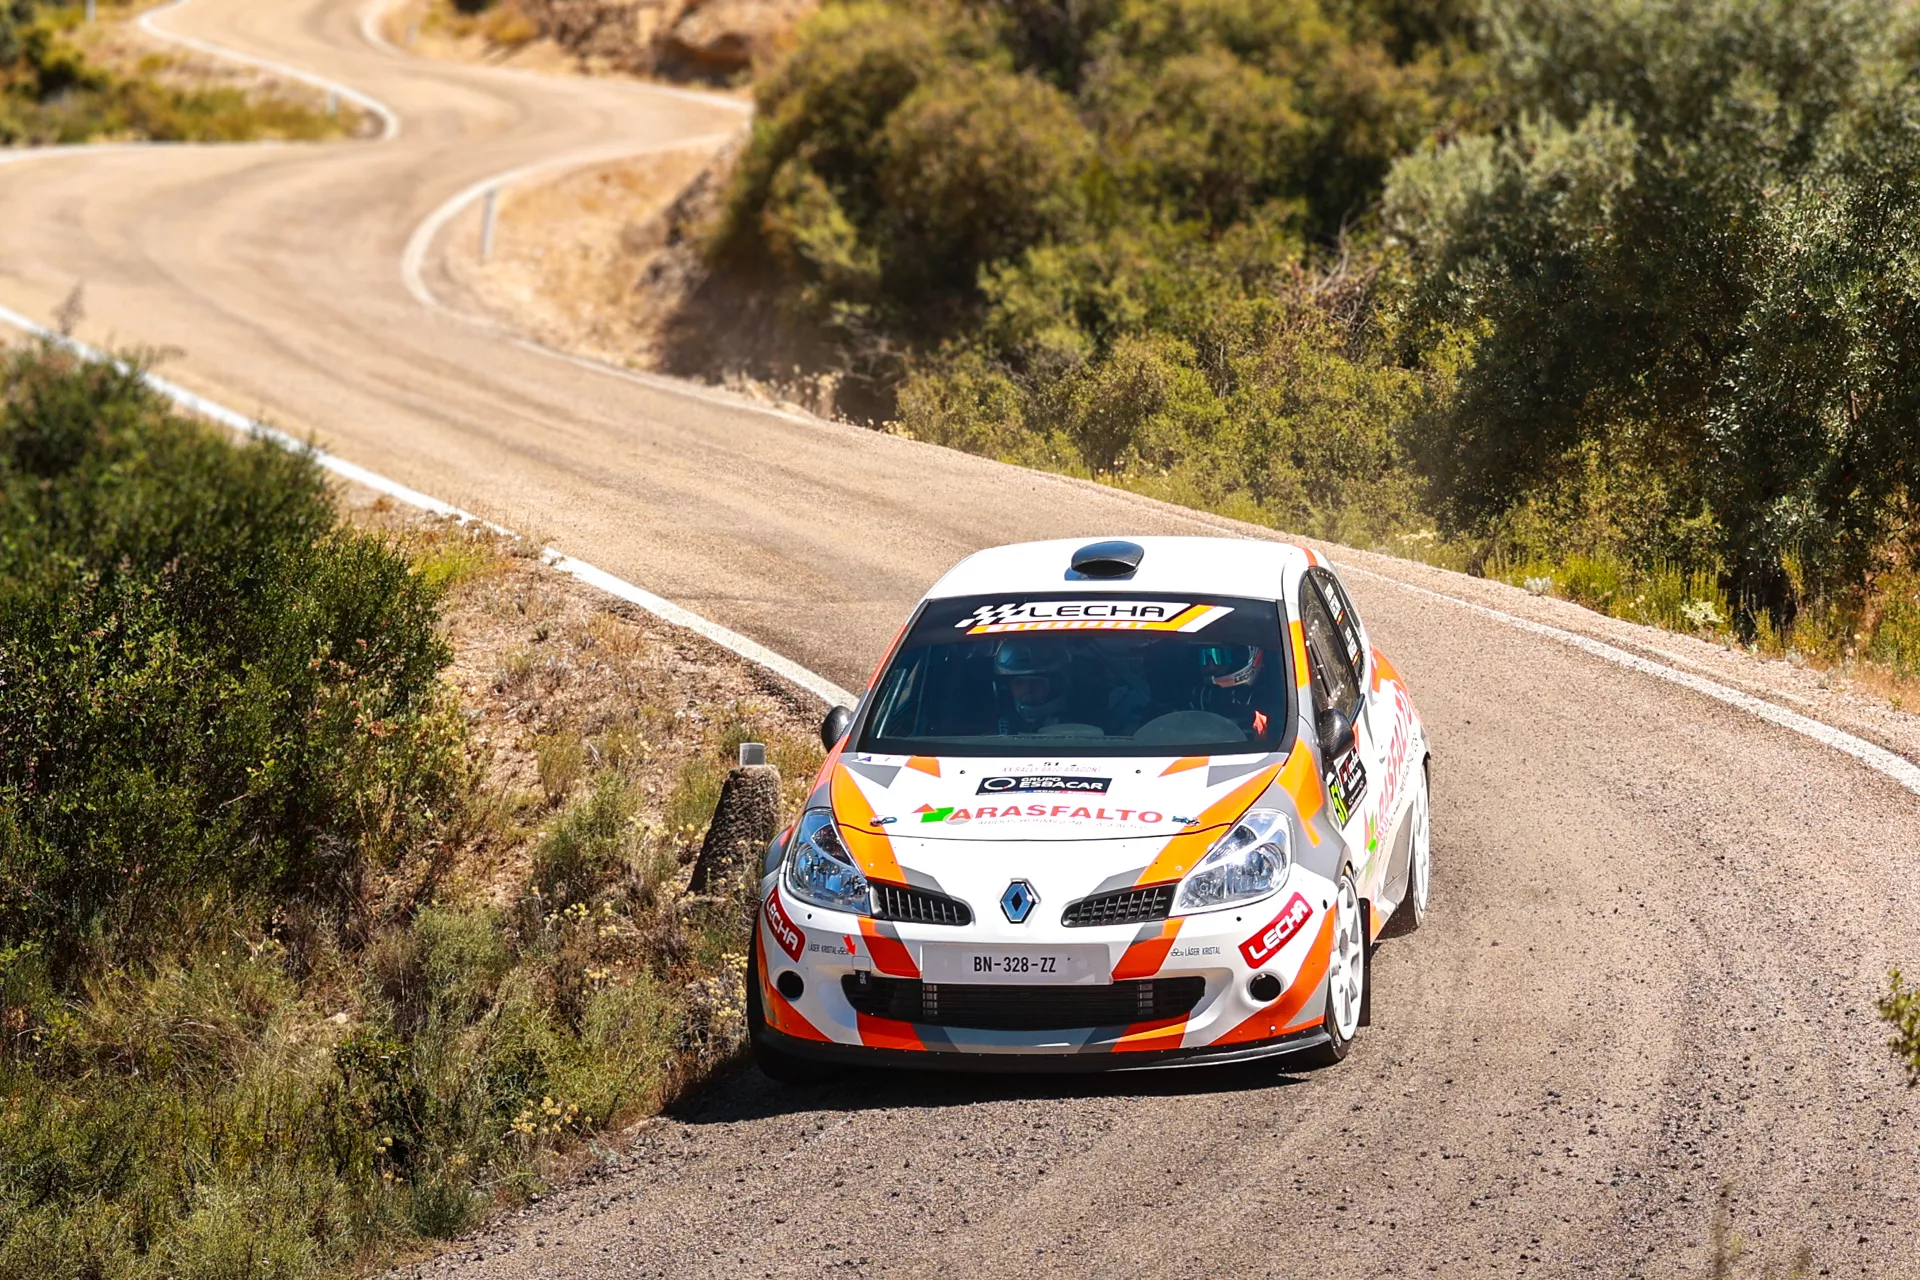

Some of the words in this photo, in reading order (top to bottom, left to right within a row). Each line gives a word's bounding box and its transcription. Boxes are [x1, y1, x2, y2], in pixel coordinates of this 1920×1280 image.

[1029, 605, 1164, 617] LECHA
[1019, 781, 1103, 790] ESBACAR
[948, 804, 1163, 823] ARASFALTO
[765, 893, 799, 952] LECHA
[1248, 899, 1308, 960] LECHA
[1201, 946, 1221, 956] KRISTAL
[973, 956, 1056, 973] BN-328-ZZ
